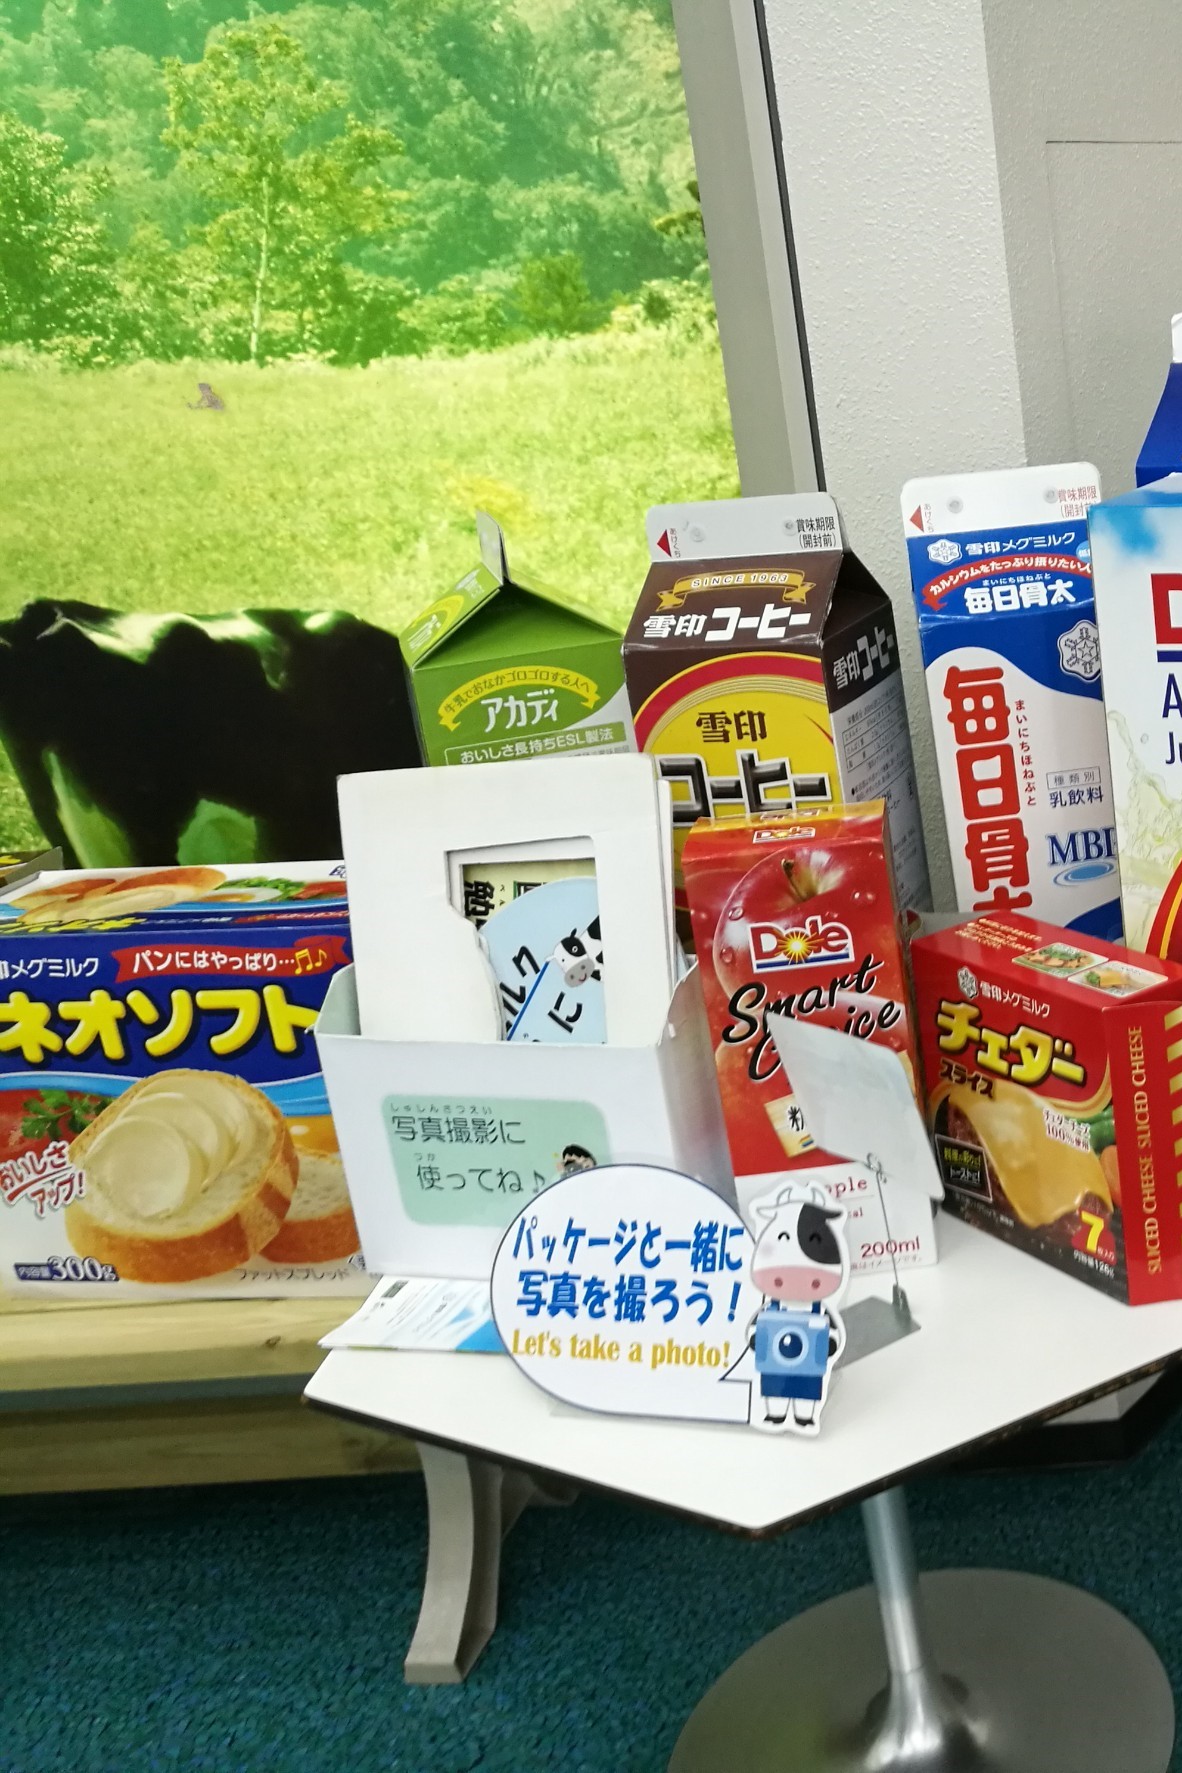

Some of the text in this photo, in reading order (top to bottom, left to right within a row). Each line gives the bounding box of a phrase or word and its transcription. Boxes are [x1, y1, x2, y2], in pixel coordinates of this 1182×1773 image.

[1057, 485, 1097, 503] 賞味期限
[795, 516, 836, 532] 賞味期限
[799, 533, 837, 548] (開封前)
[965, 532, 1076, 557] 雪印メグミルク
[691, 573, 789, 588] SINCE 1963
[964, 579, 1076, 614] 毎日骨太
[982, 573, 1051, 587] まいにちほねぶと
[643, 603, 811, 642] 雪印コーヒー
[832, 626, 896, 690] 雪印コーヒー
[444, 669, 591, 714] 牛乳でおなかゴロゴロする人へ
[481, 688, 559, 733] アカディ
[460, 728, 614, 764] おいしさ長持ちESL製法
[695, 710, 767, 744] 雪印
[1014, 699, 1037, 806] まいにちほねぶと
[656, 747, 832, 827] コーヒー
[1049, 786, 1104, 809] 乳飲料
[1053, 770, 1096, 787] 種類別
[750, 916, 852, 968] Dole
[548, 991, 583, 1034] に
[722, 954, 885, 1043] Smart
[979, 980, 1051, 1018] 雪印メグミルク
[0, 984, 319, 1064] ネオソフト
[748, 1000, 902, 1081] Cice
[938, 1000, 1086, 1086] チェダー
[940, 1058, 994, 1099] スライス
[391, 1103, 492, 1115] しゃしんさつえい
[1043, 1107, 1091, 1139] チェダーチーズ
[392, 1116, 526, 1145] 写真撮影に
[1128, 1025, 1162, 1275] SLICED CHEESE SLICED CHEESE
[0, 1143, 70, 1191] おいしさ
[826, 1177, 868, 1198] ple
[512, 1216, 744, 1273] パッケージと一緒に
[861, 1235, 920, 1258] 200ml
[516, 1270, 742, 1325] 写真を撮ろう!
[512, 1329, 731, 1370] Let's take a photo!
